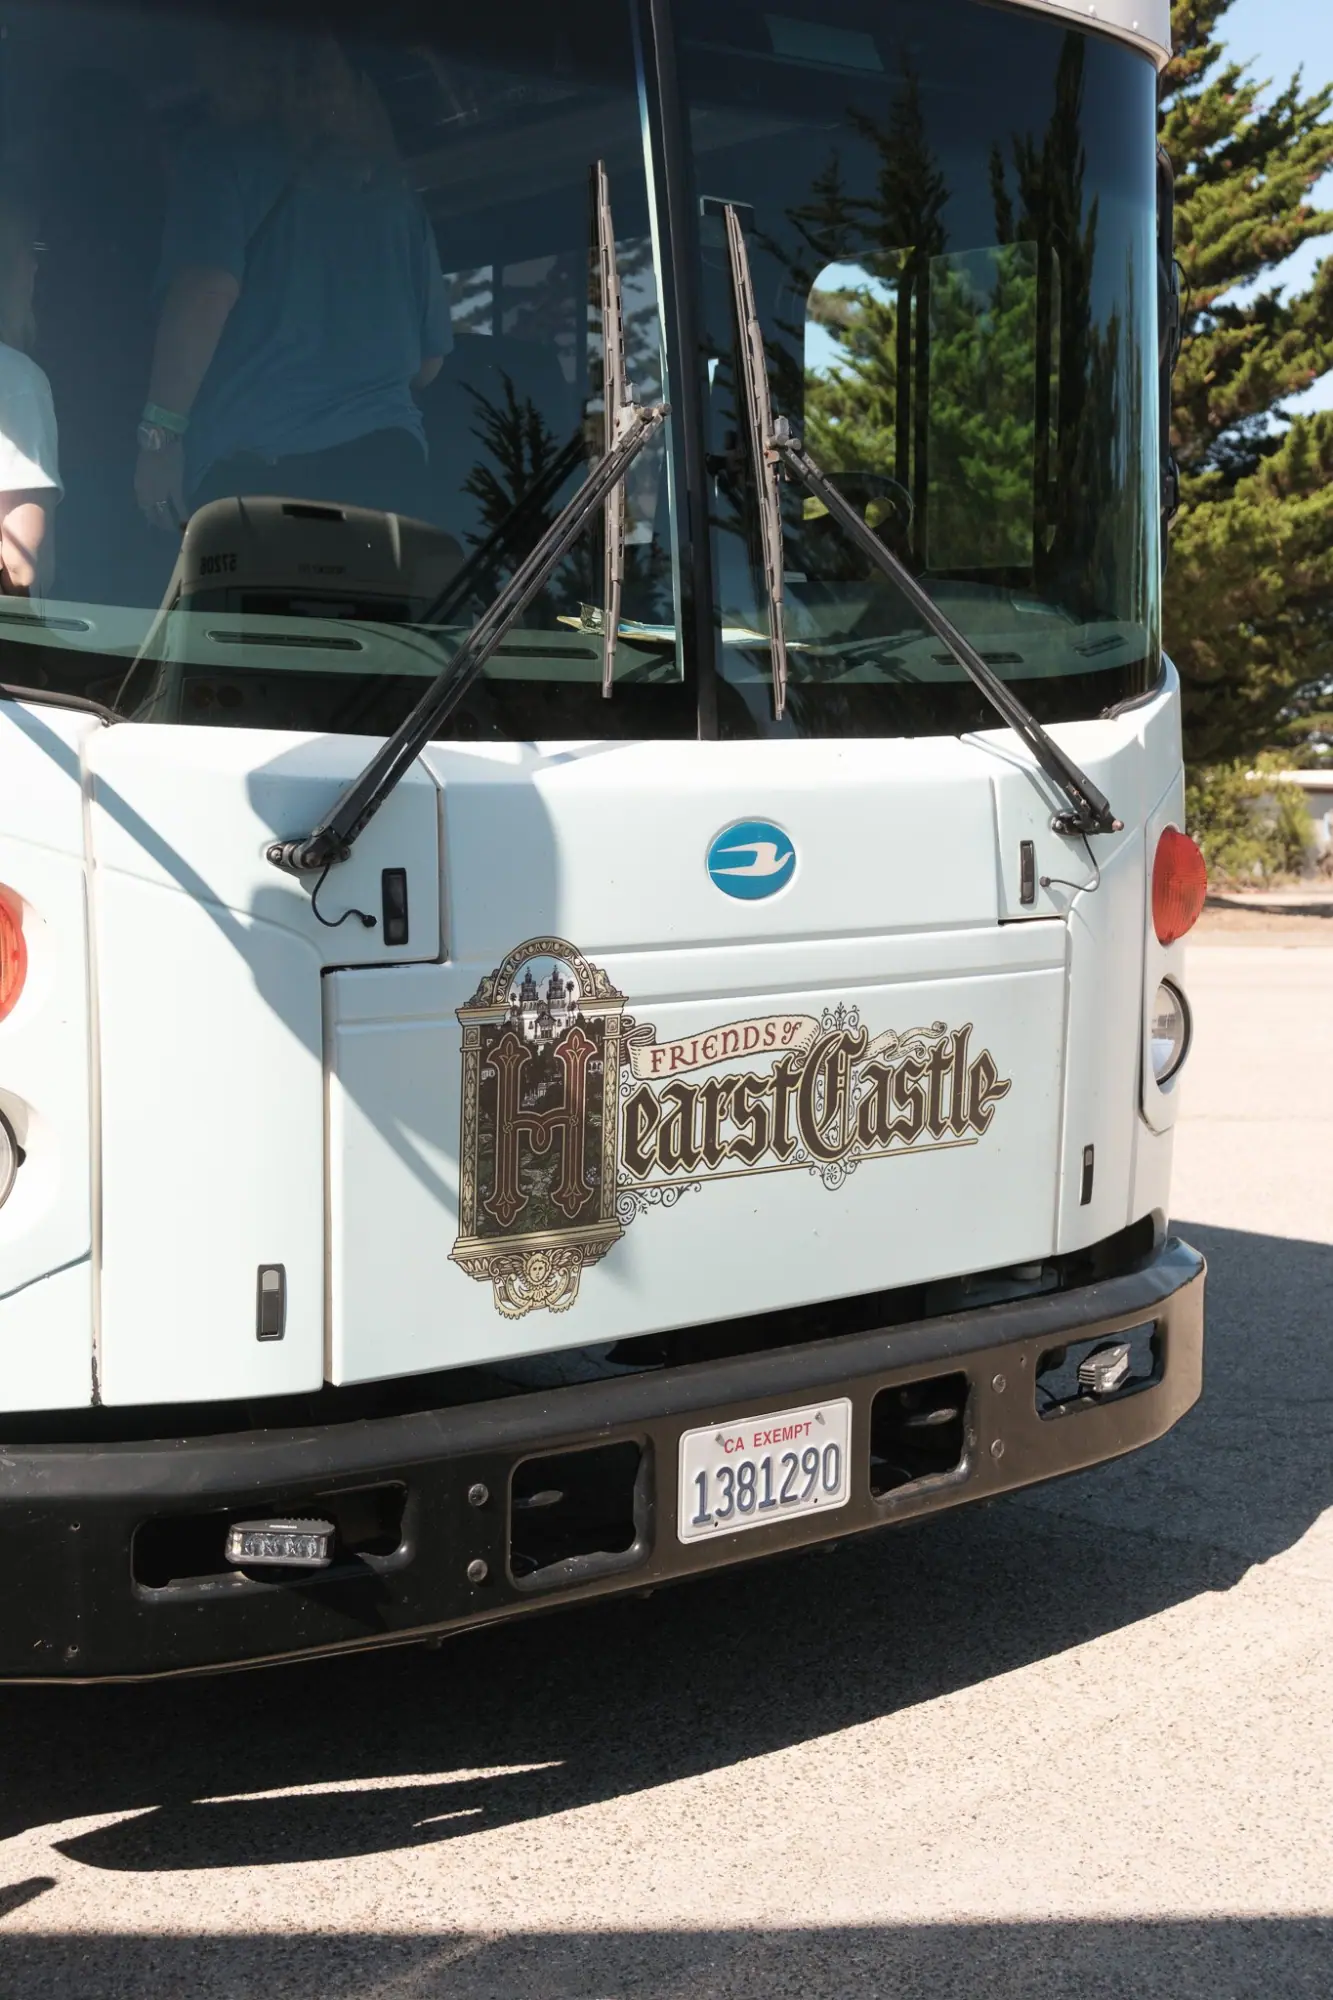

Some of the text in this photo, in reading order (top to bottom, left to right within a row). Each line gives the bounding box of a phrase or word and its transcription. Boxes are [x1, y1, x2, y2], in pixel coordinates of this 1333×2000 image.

[650, 1021, 803, 1073] FRIENDS of
[483, 1022, 1012, 1227] Hearst Castle
[723, 1421, 812, 1454] CA EXEMPT
[692, 1442, 841, 1525] 1381290
